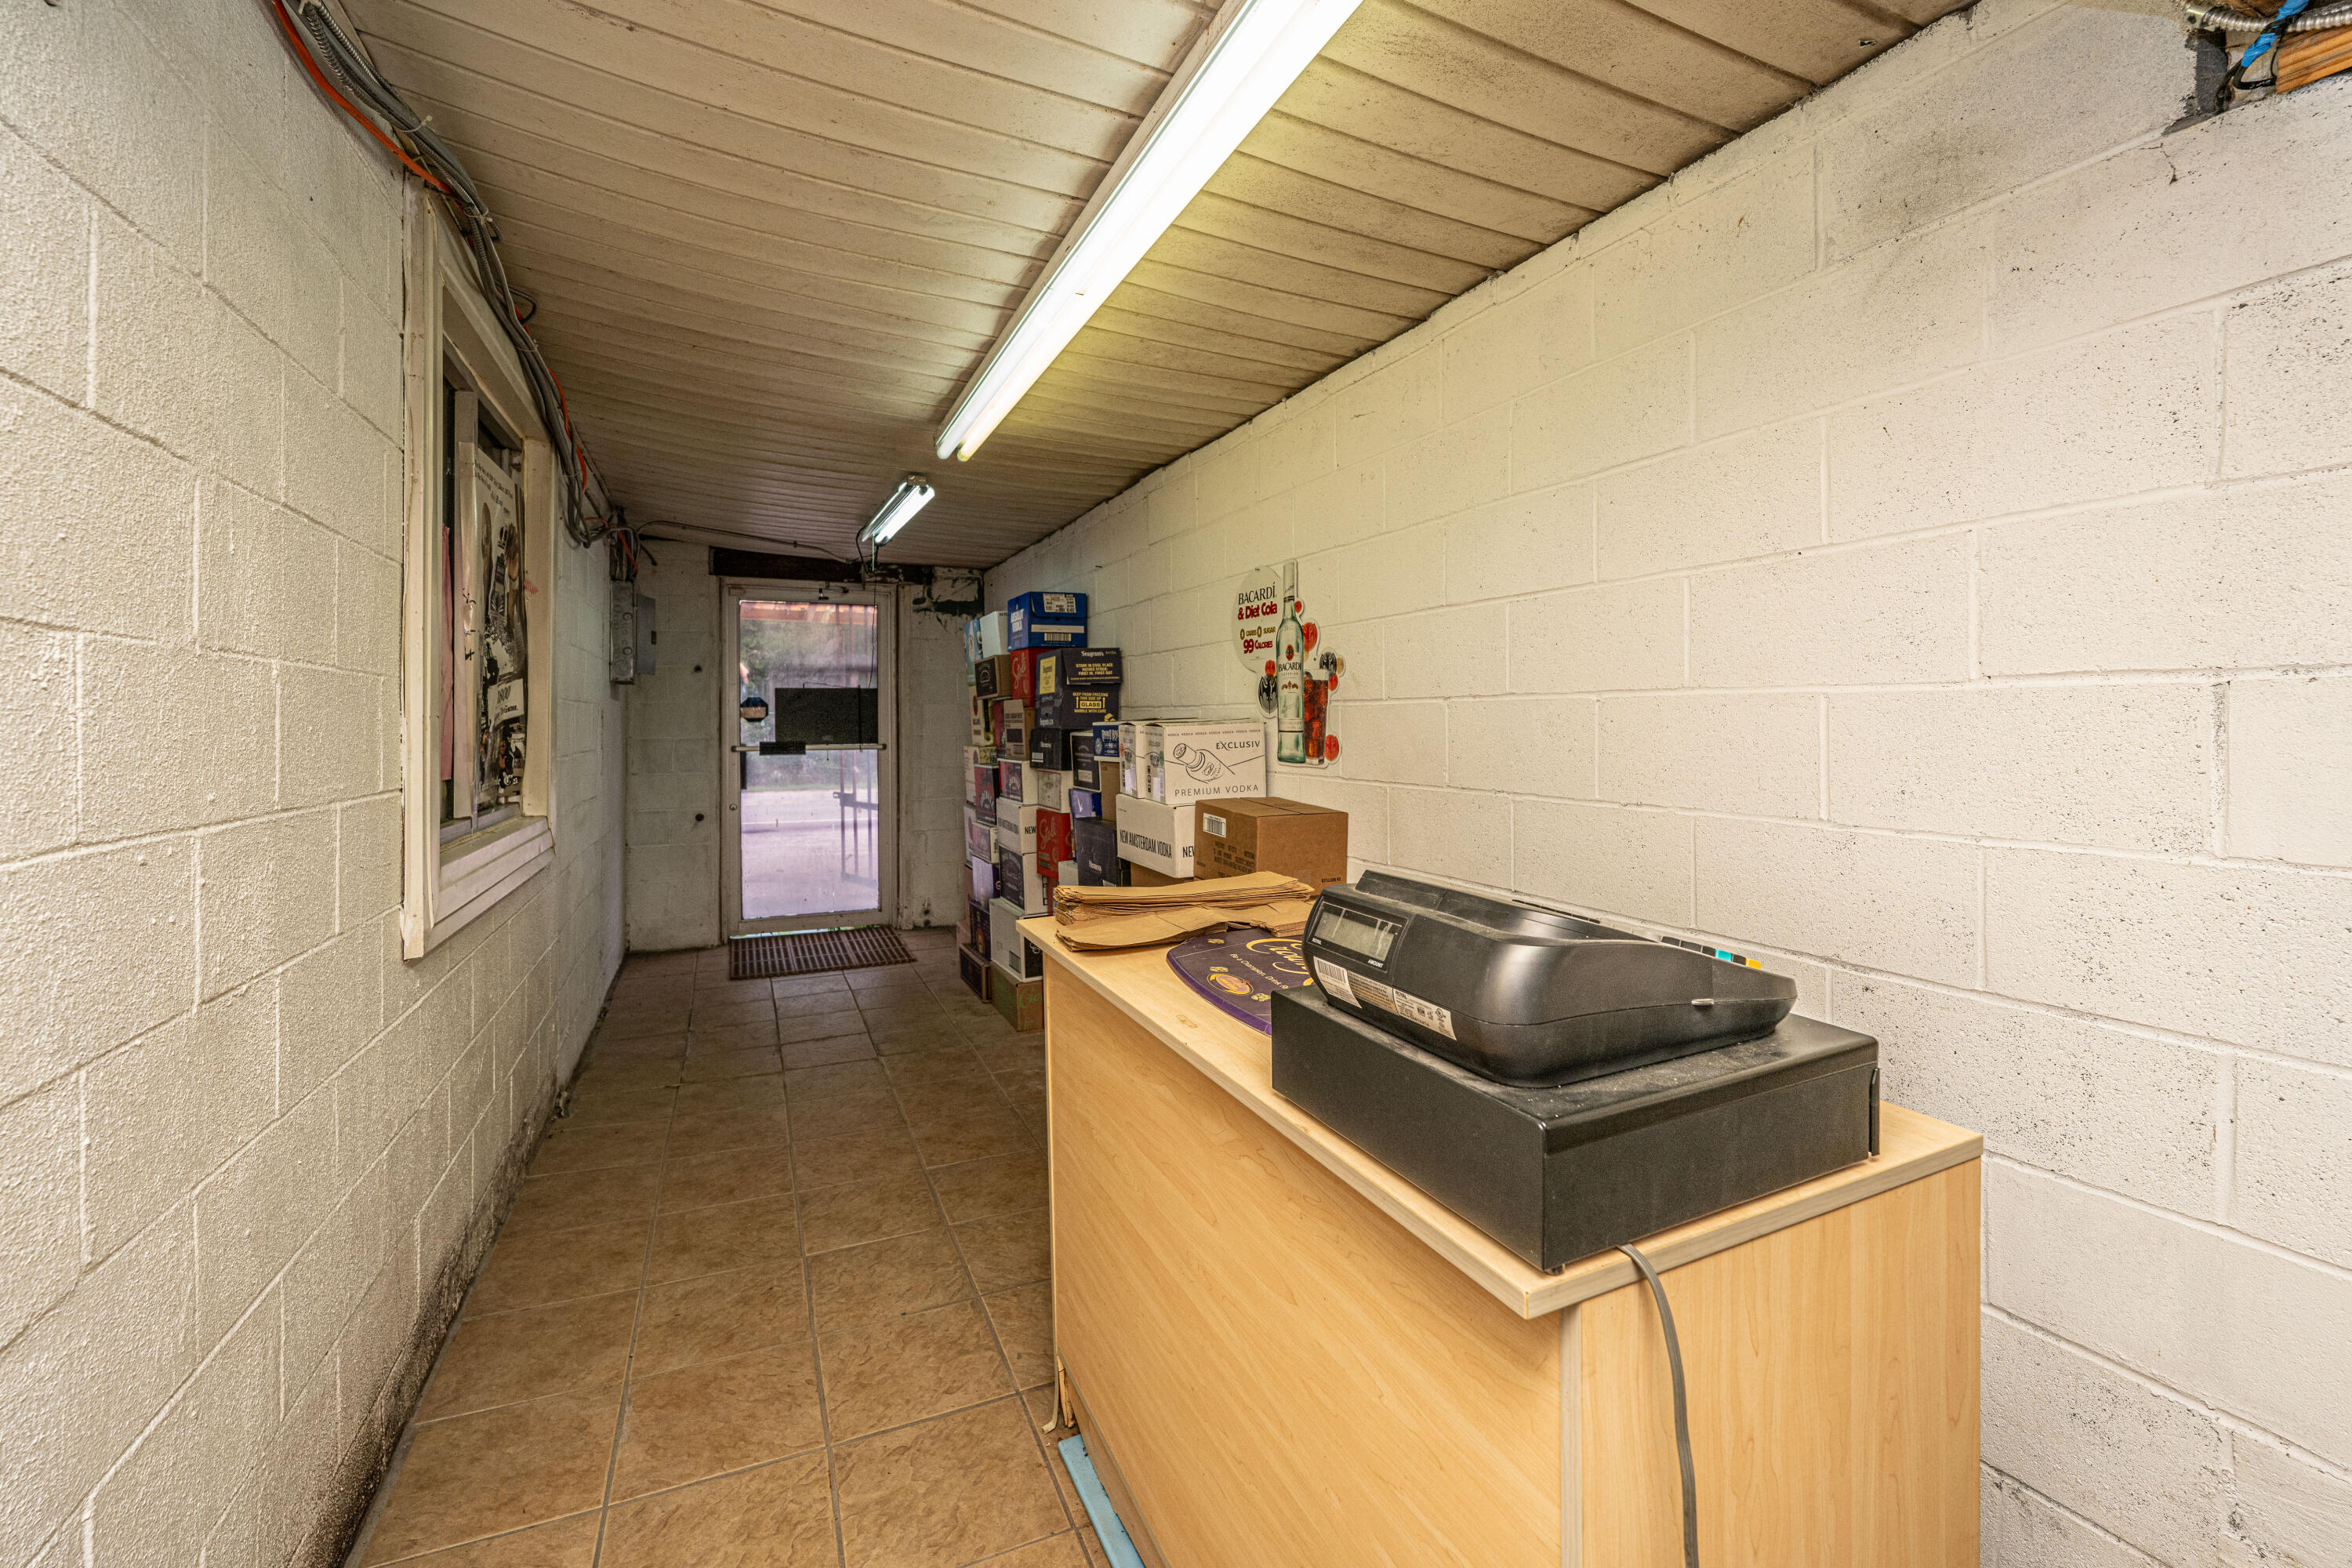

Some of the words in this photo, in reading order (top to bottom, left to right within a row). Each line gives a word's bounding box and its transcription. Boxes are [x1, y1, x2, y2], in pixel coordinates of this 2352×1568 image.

[1238, 582, 1276, 605] BACARDÍ
[1237, 607, 1244, 620] &
[1245, 604, 1260, 619] Diet
[1261, 601, 1278, 616] Cola
[1243, 639, 1254, 654] 99
[1216, 740, 1261, 752] EXCLUSIV
[1174, 786, 1221, 797] PREMIUM
[1225, 784, 1259, 793] VODKA
[1120, 829, 1128, 844] NEW
[1128, 832, 1156, 854] AMSTERDAM
[1157, 840, 1173, 858] VODKA
[1367, 959, 1384, 968] AMOUNT
